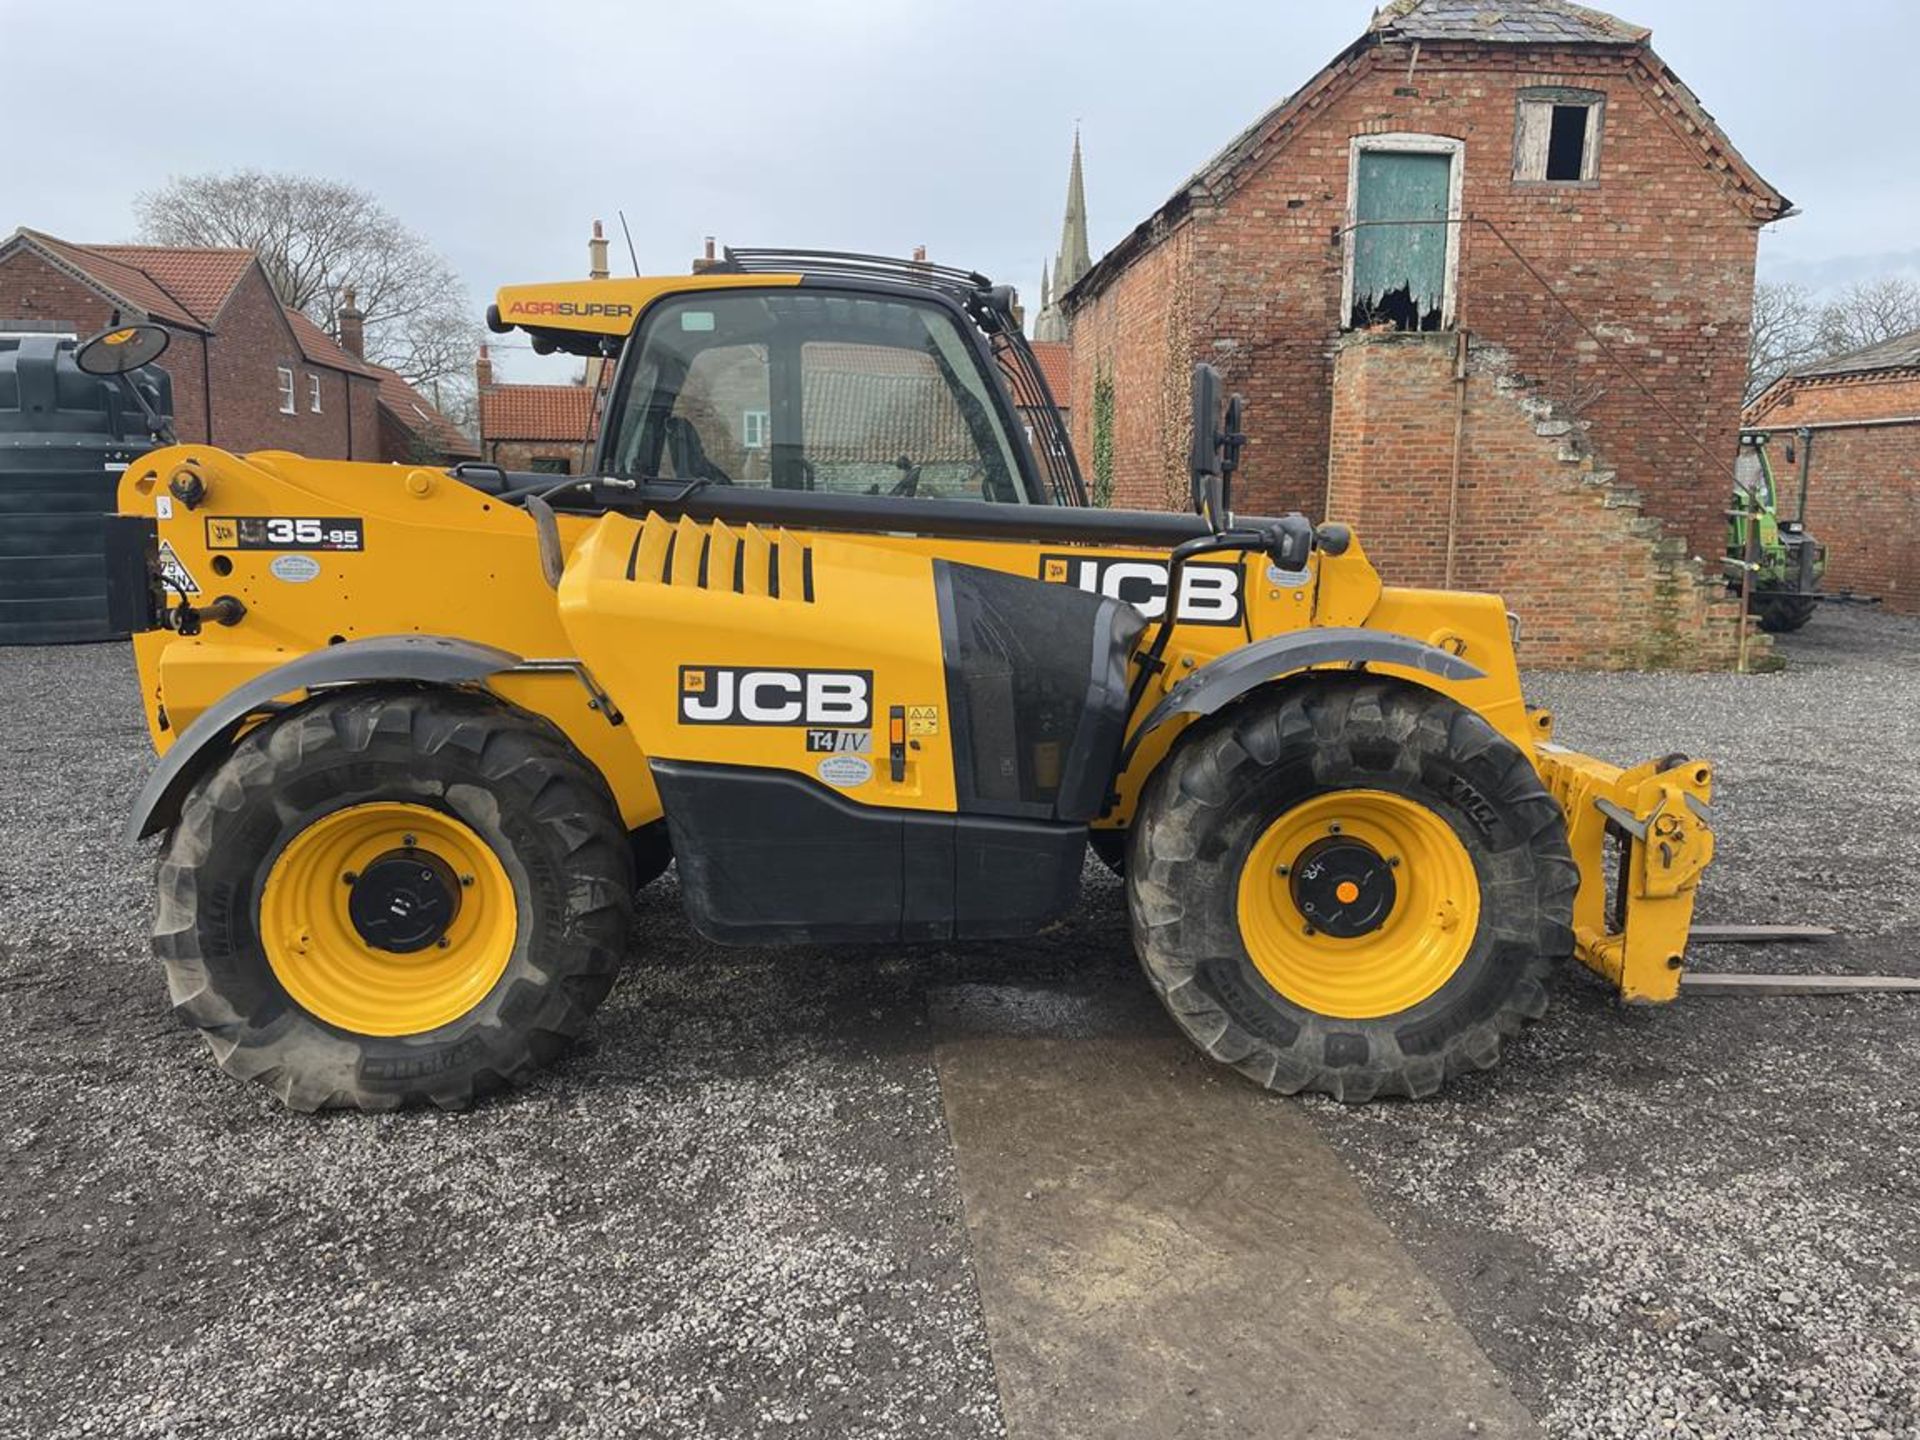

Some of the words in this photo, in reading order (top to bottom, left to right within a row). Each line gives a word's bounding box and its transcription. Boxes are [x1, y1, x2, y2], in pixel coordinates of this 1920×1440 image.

[510, 301, 632, 317] AGRISUPER
[240, 519, 358, 543] 35-95
[683, 671, 868, 723] JCB
